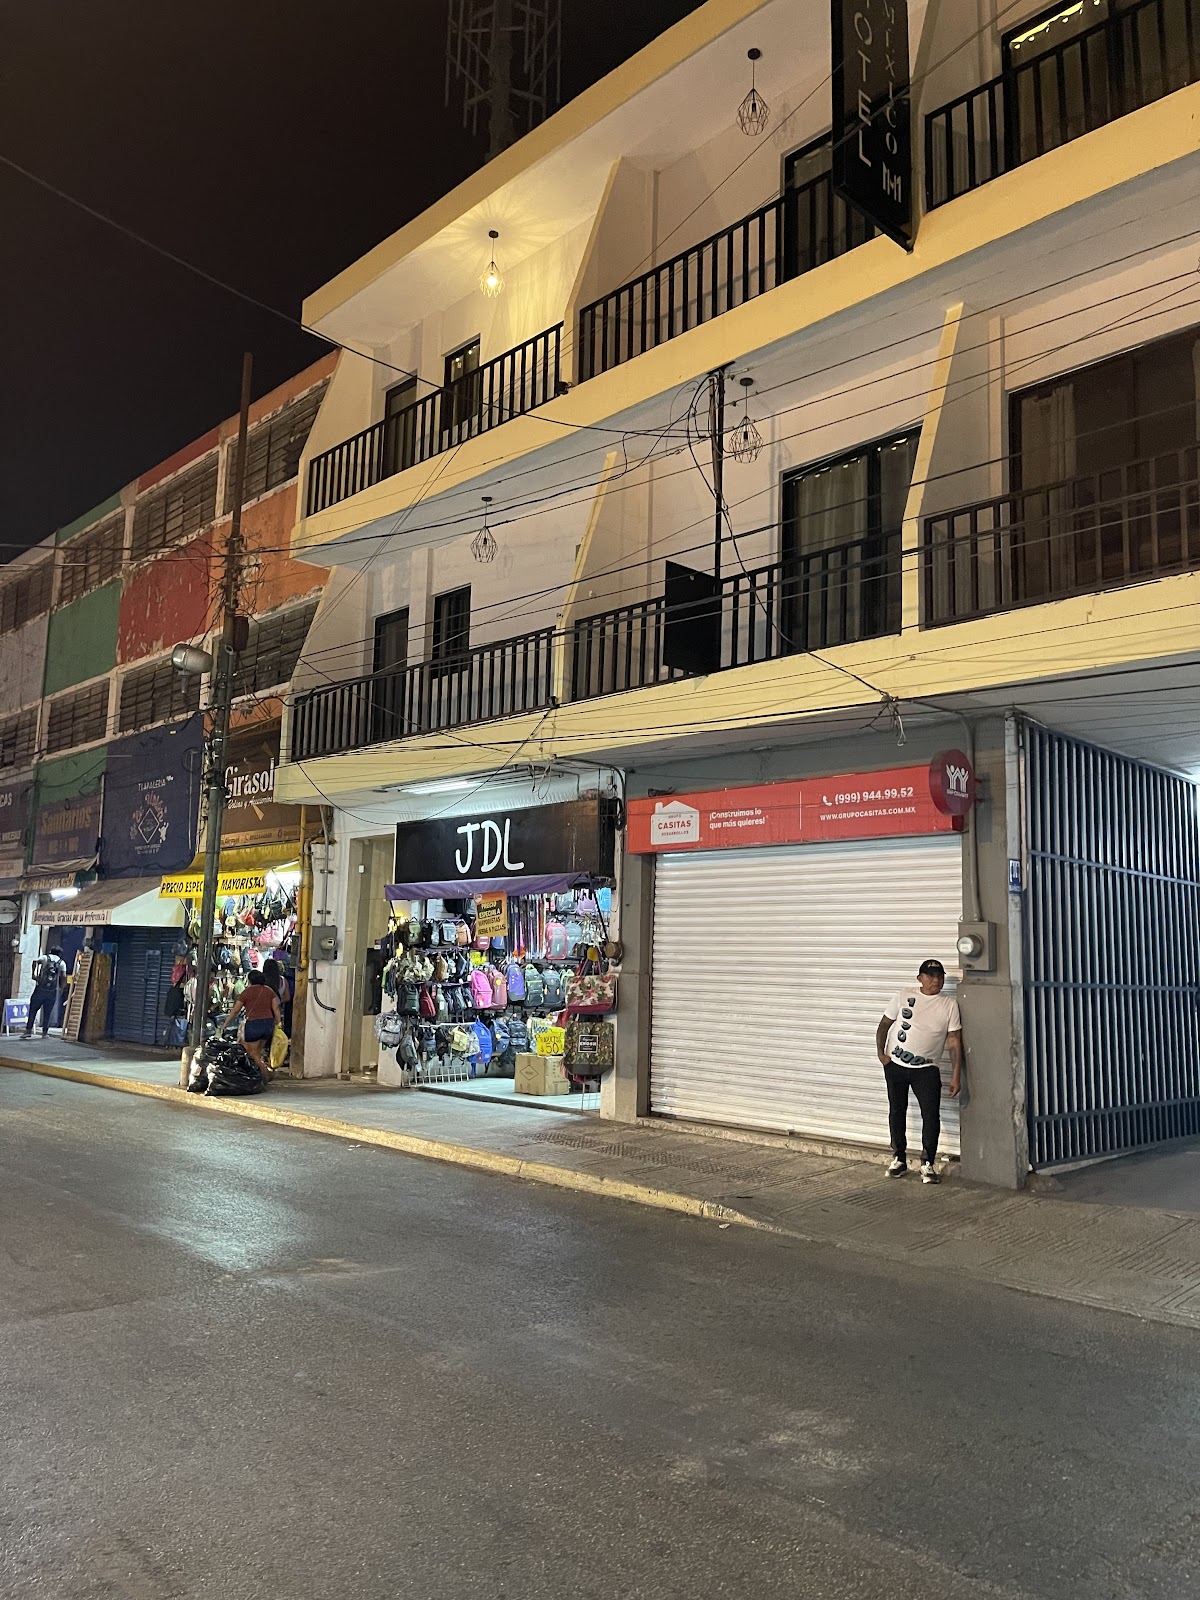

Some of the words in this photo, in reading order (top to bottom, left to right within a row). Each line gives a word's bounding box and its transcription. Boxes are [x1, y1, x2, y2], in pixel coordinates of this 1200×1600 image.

[225, 757, 274, 799] Girasol
[835, 793, 860, 805] (999)
[863, 787, 914, 801] 944.99.52
[754, 807, 762, 817] lo
[820, 806, 916, 821] WWW.GRUPOCASITAS.COM.MX
[657, 820, 692, 830] CASITAS
[709, 821, 722, 831] que
[723, 819, 737, 828] más
[737, 816, 766, 829] quieres!
[455, 818, 524, 874] JDL
[161, 881, 184, 893] PRECIO
[221, 877, 265, 890] MAYORISTAS
